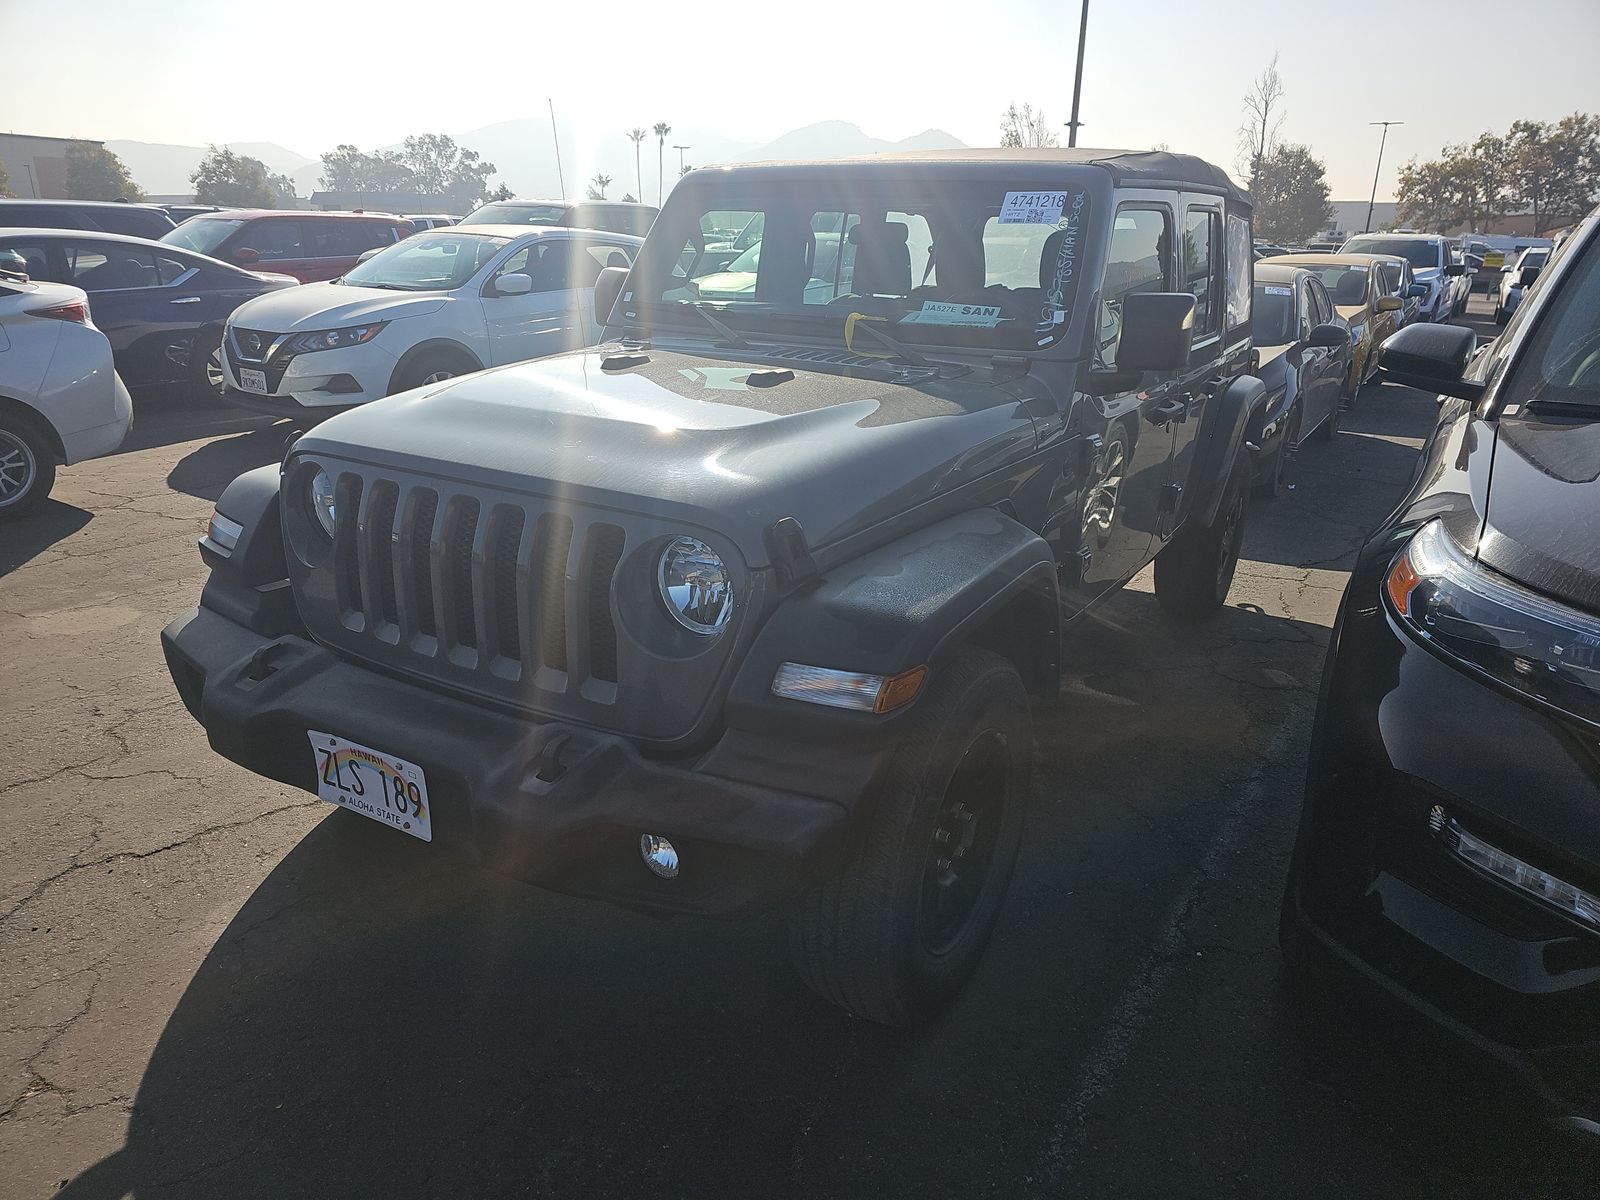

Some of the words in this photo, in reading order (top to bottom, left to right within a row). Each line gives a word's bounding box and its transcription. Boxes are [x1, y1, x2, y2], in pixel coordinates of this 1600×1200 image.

[1010, 194, 1066, 208] 4741218
[924, 303, 957, 313] JA527E
[961, 305, 996, 317] SAN
[349, 747, 384, 766] HAWAII
[318, 747, 365, 797] ZLS
[379, 769, 422, 818] 189
[348, 797, 375, 814] ALOHA
[376, 807, 402, 825] STATE
